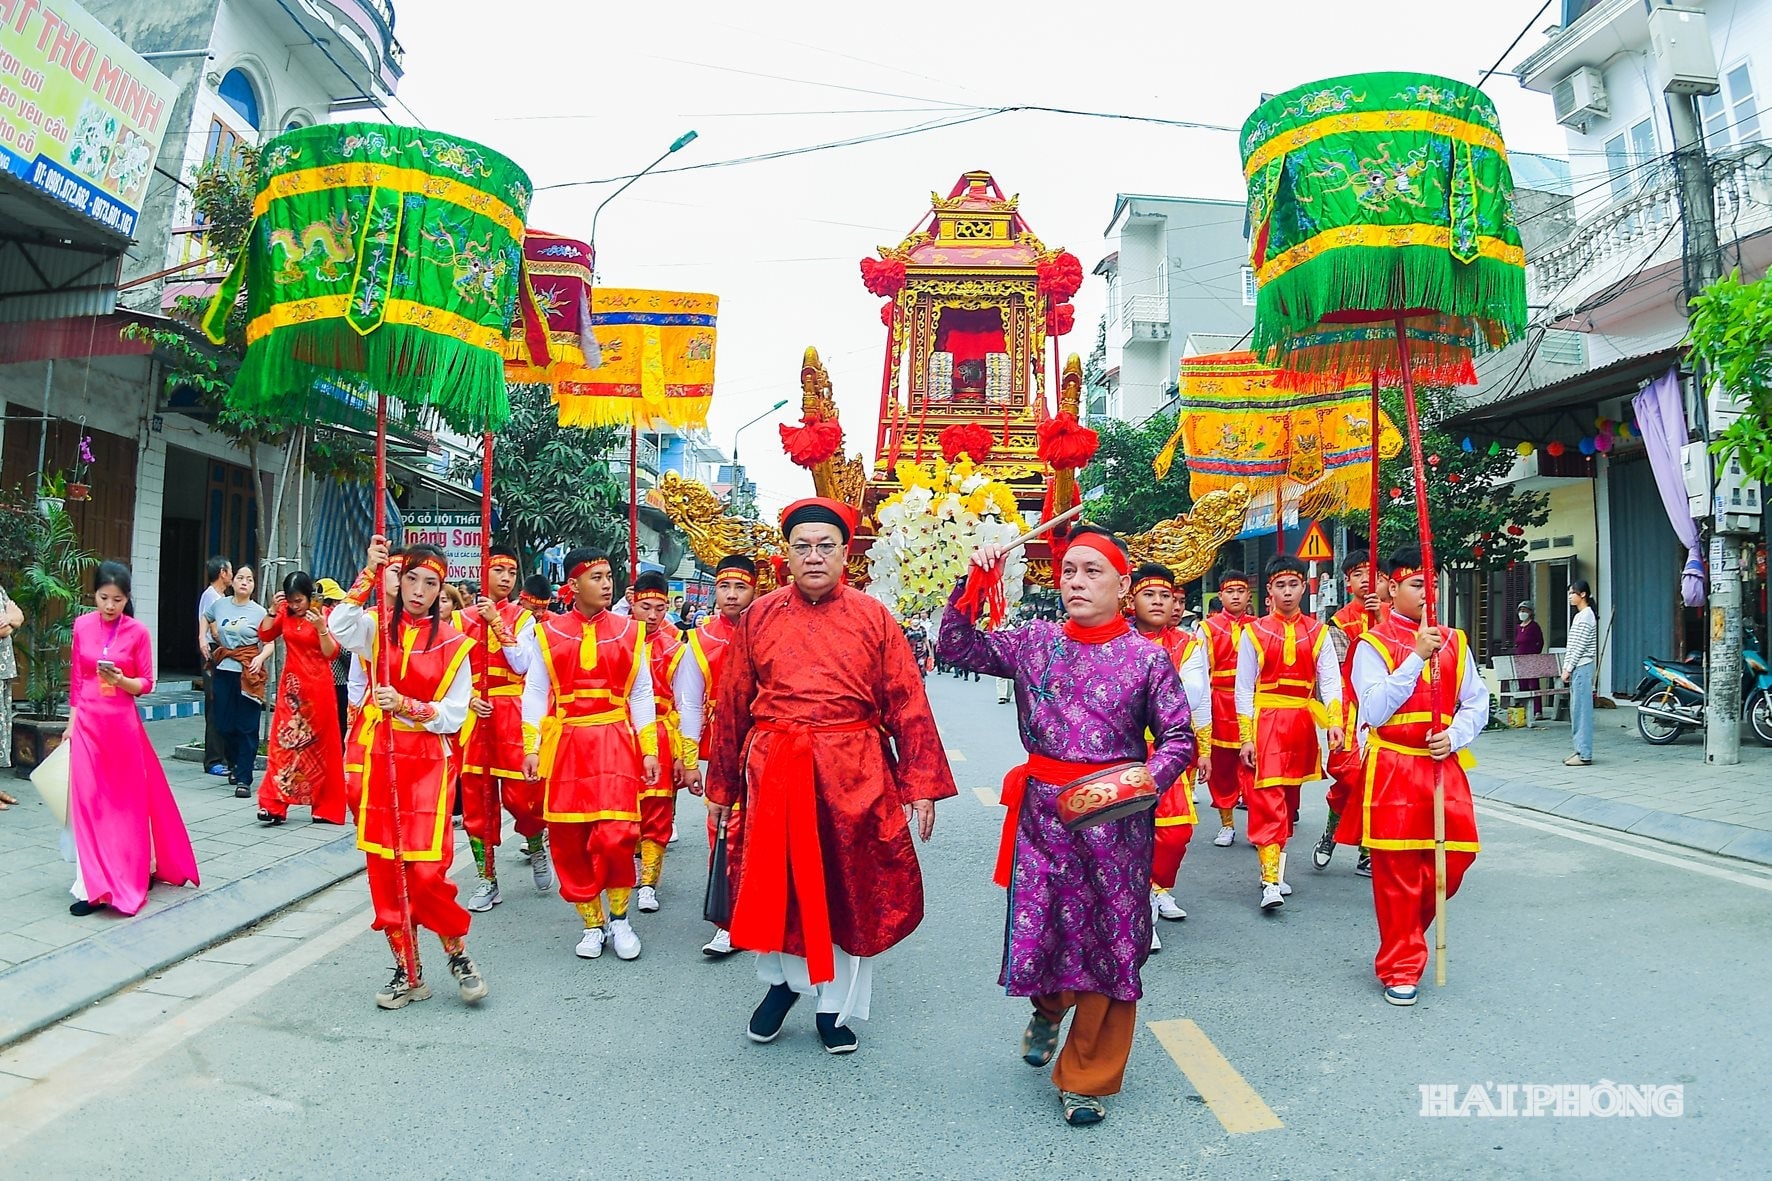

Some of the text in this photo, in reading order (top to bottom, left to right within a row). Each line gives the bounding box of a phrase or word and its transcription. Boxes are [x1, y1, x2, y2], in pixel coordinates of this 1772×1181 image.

[21, 68, 44, 93] gói
[36, 8, 98, 83] THU
[92, 56, 165, 134] MINH
[0, 84, 68, 143] eo yêu cầu
[16, 129, 34, 154] cỗ
[454, 512, 481, 524] THẤT
[452, 529, 482, 546] Sơn
[448, 559, 466, 578] ỒNG
